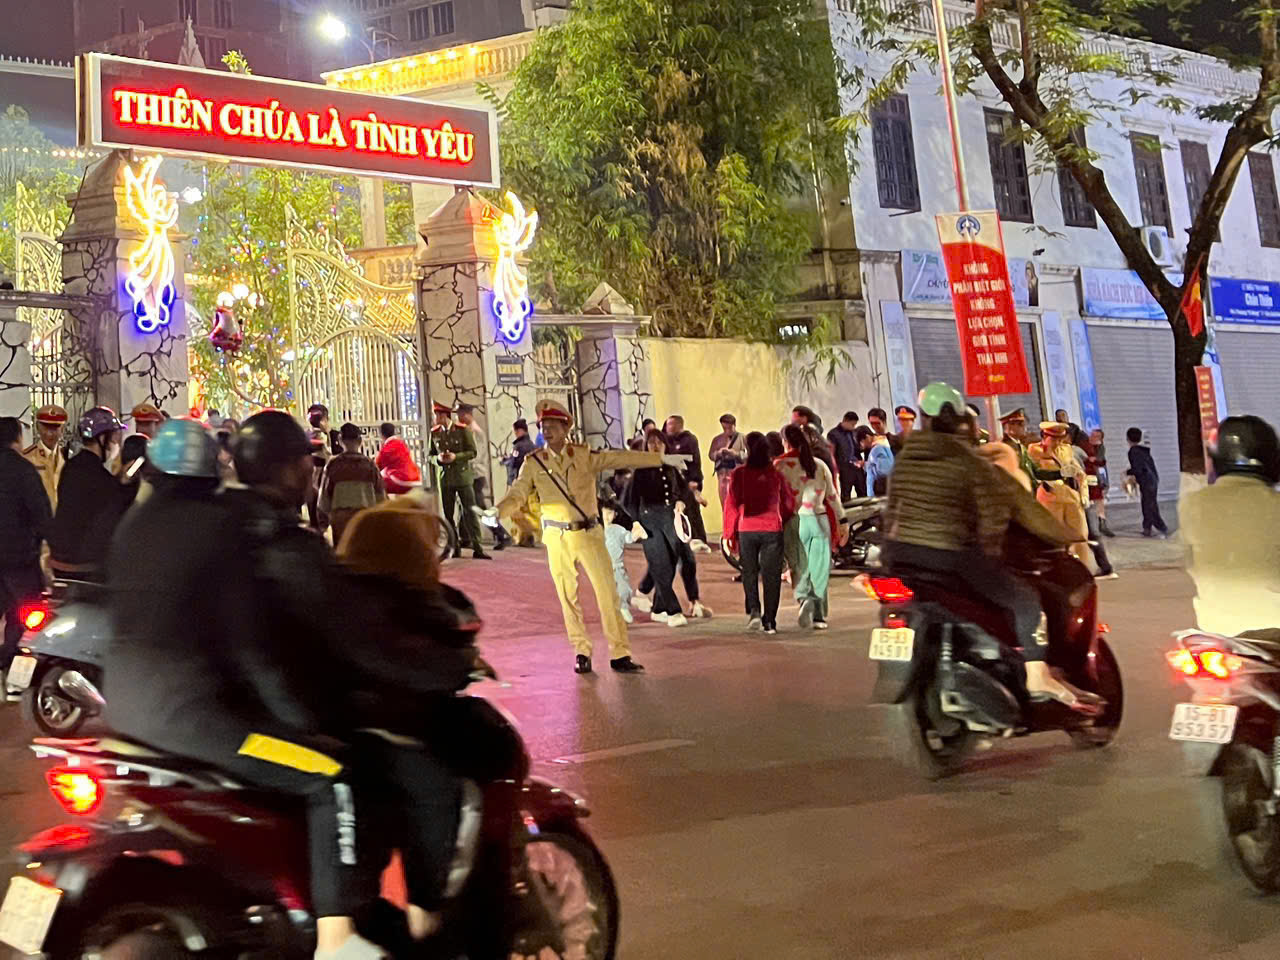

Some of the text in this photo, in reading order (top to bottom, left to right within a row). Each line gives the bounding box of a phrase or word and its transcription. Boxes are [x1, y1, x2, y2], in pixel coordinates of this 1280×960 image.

[114, 88, 474, 162] THIÊN CHÚA LÀ TÌNH YÊU
[963, 261, 989, 275] KHÔNG
